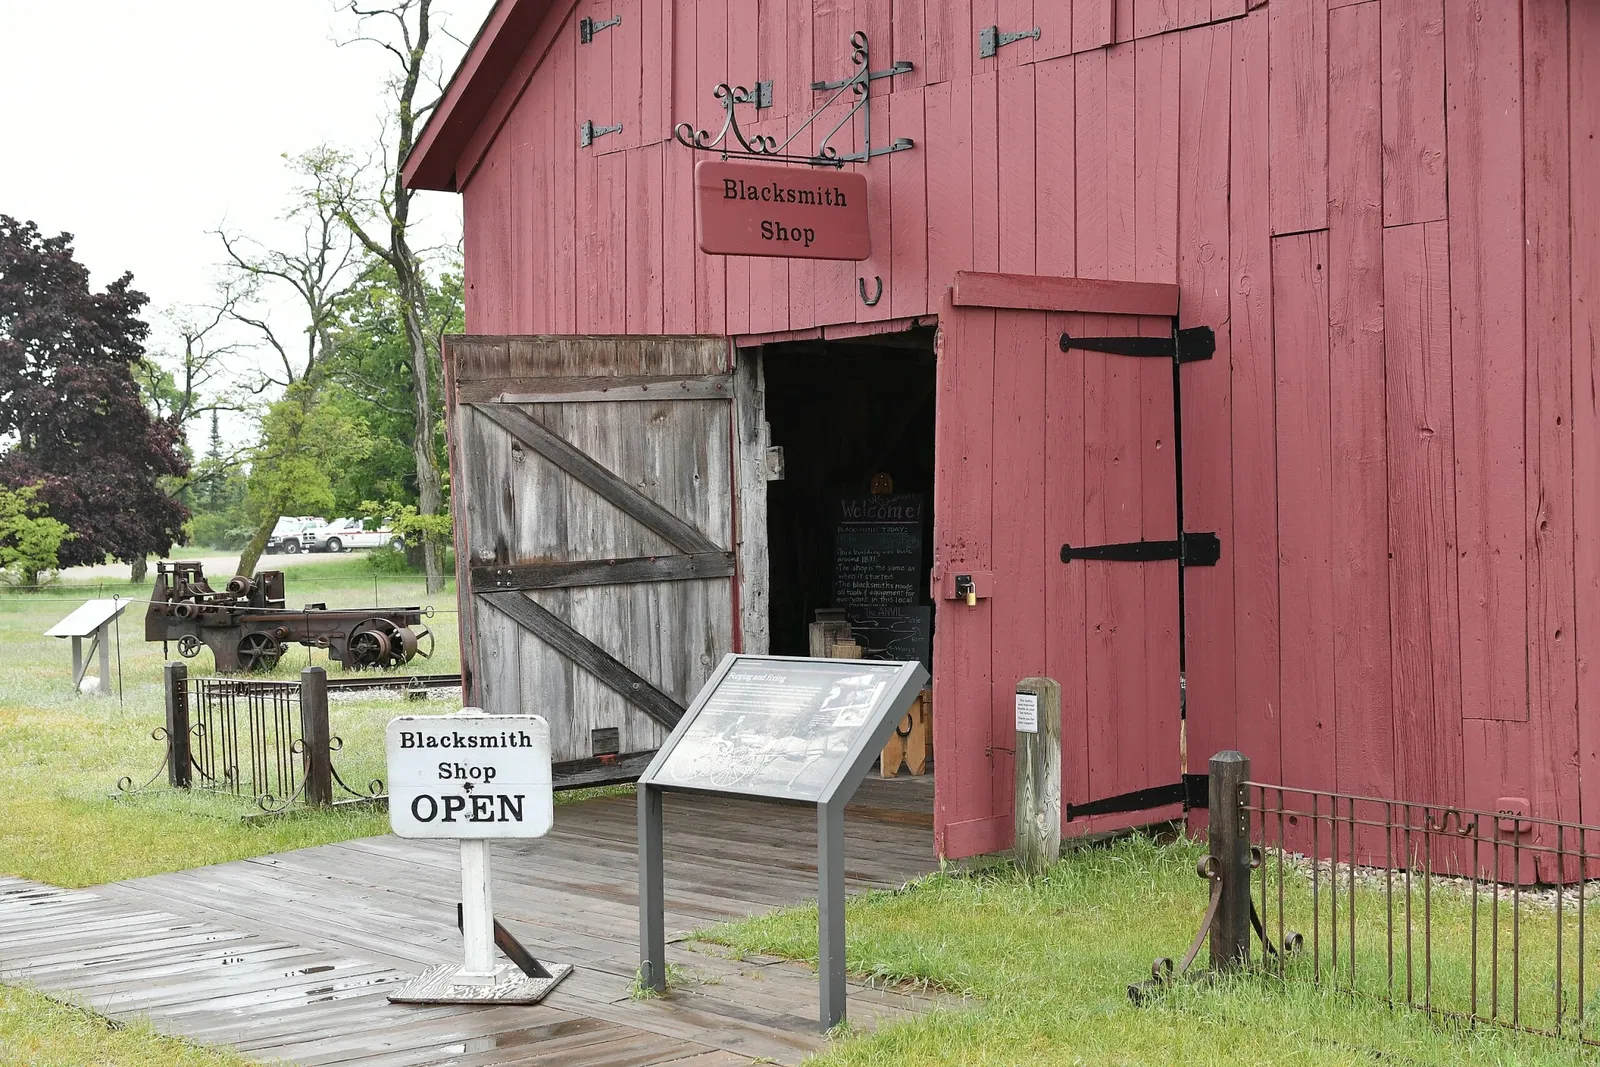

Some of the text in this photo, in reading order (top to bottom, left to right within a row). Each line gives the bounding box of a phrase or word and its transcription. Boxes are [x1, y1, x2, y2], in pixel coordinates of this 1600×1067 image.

[722, 178, 848, 207] Blacksmith
[760, 220, 815, 247] Shop
[840, 499, 921, 519] Welcome!
[728, 672, 787, 684] Forging and fixing
[399, 731, 533, 749] Blacksmith
[438, 762, 497, 784] Shop
[411, 793, 526, 823] OPEN
